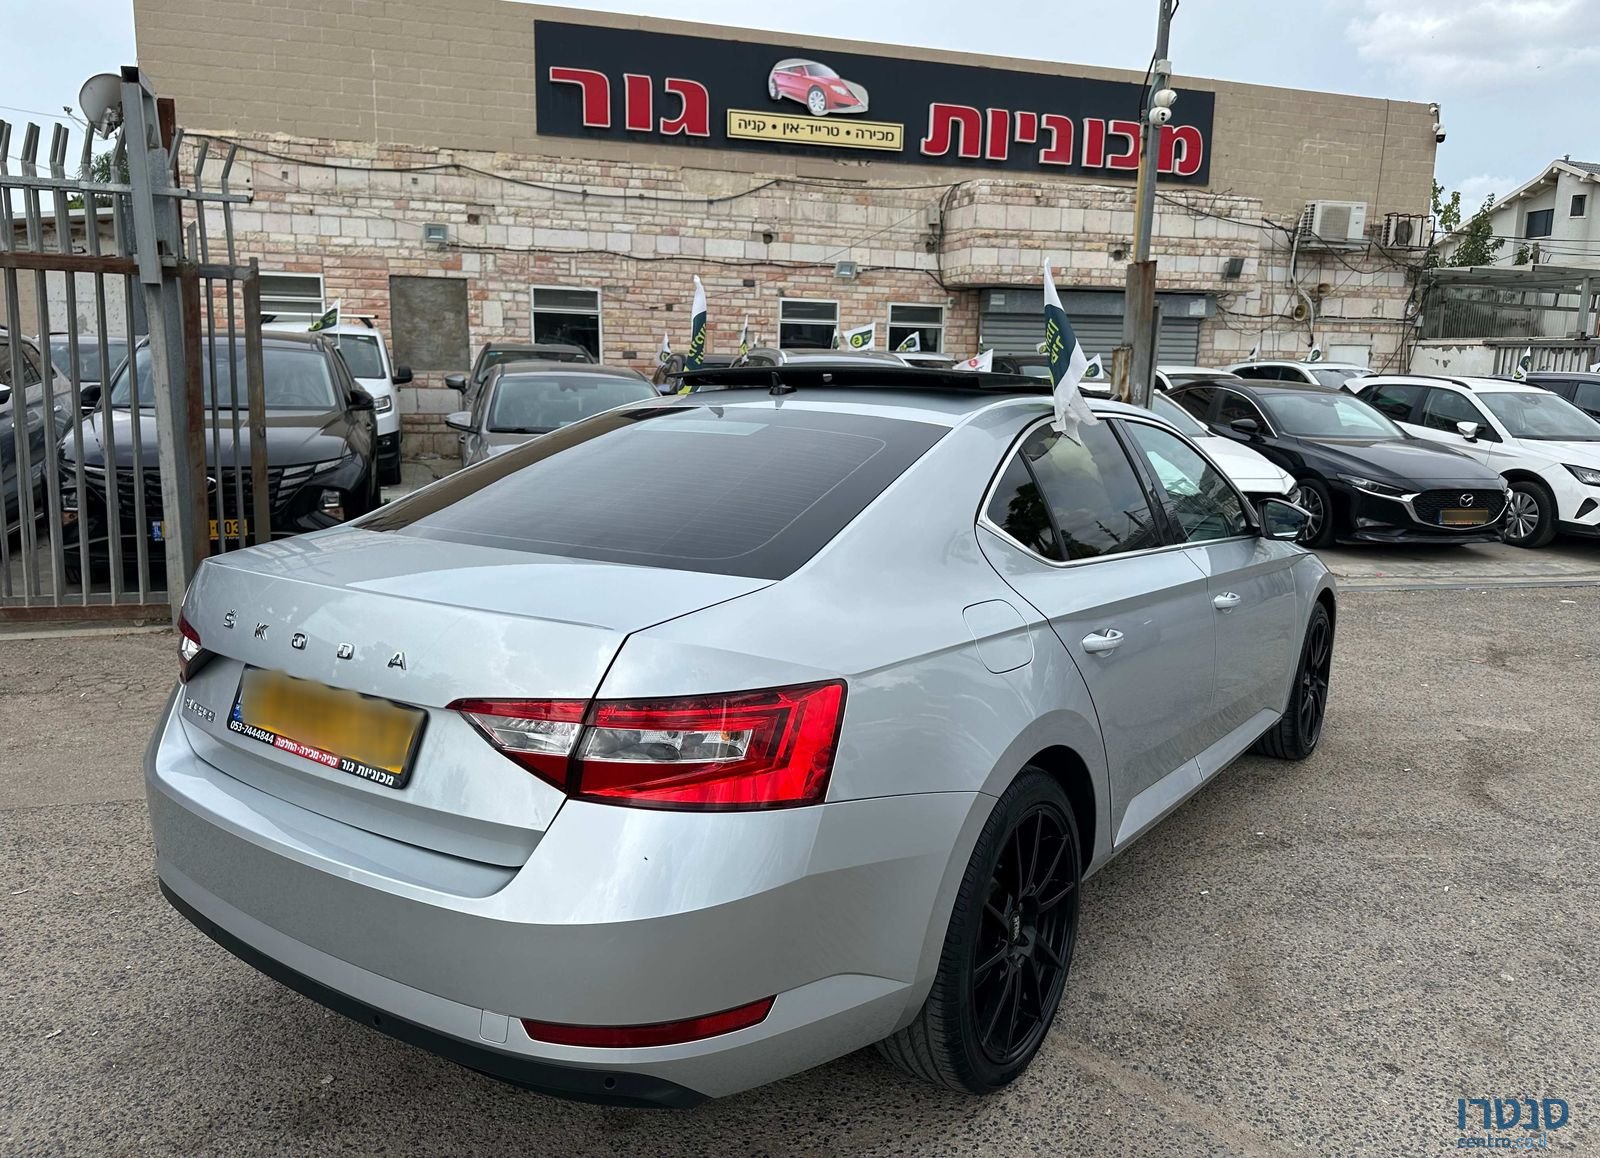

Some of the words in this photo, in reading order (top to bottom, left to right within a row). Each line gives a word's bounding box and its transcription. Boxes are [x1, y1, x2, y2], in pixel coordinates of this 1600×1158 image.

[549, 66, 711, 137] גור
[737, 117, 767, 133] קניה
[782, 121, 840, 137] טרייד-אין
[855, 128, 895, 142] מכירה
[920, 102, 1204, 176] מכוניות
[229, 720, 275, 744] 053-7444844
[341, 759, 356, 773] גור
[356, 764, 394, 786] מכוניות
